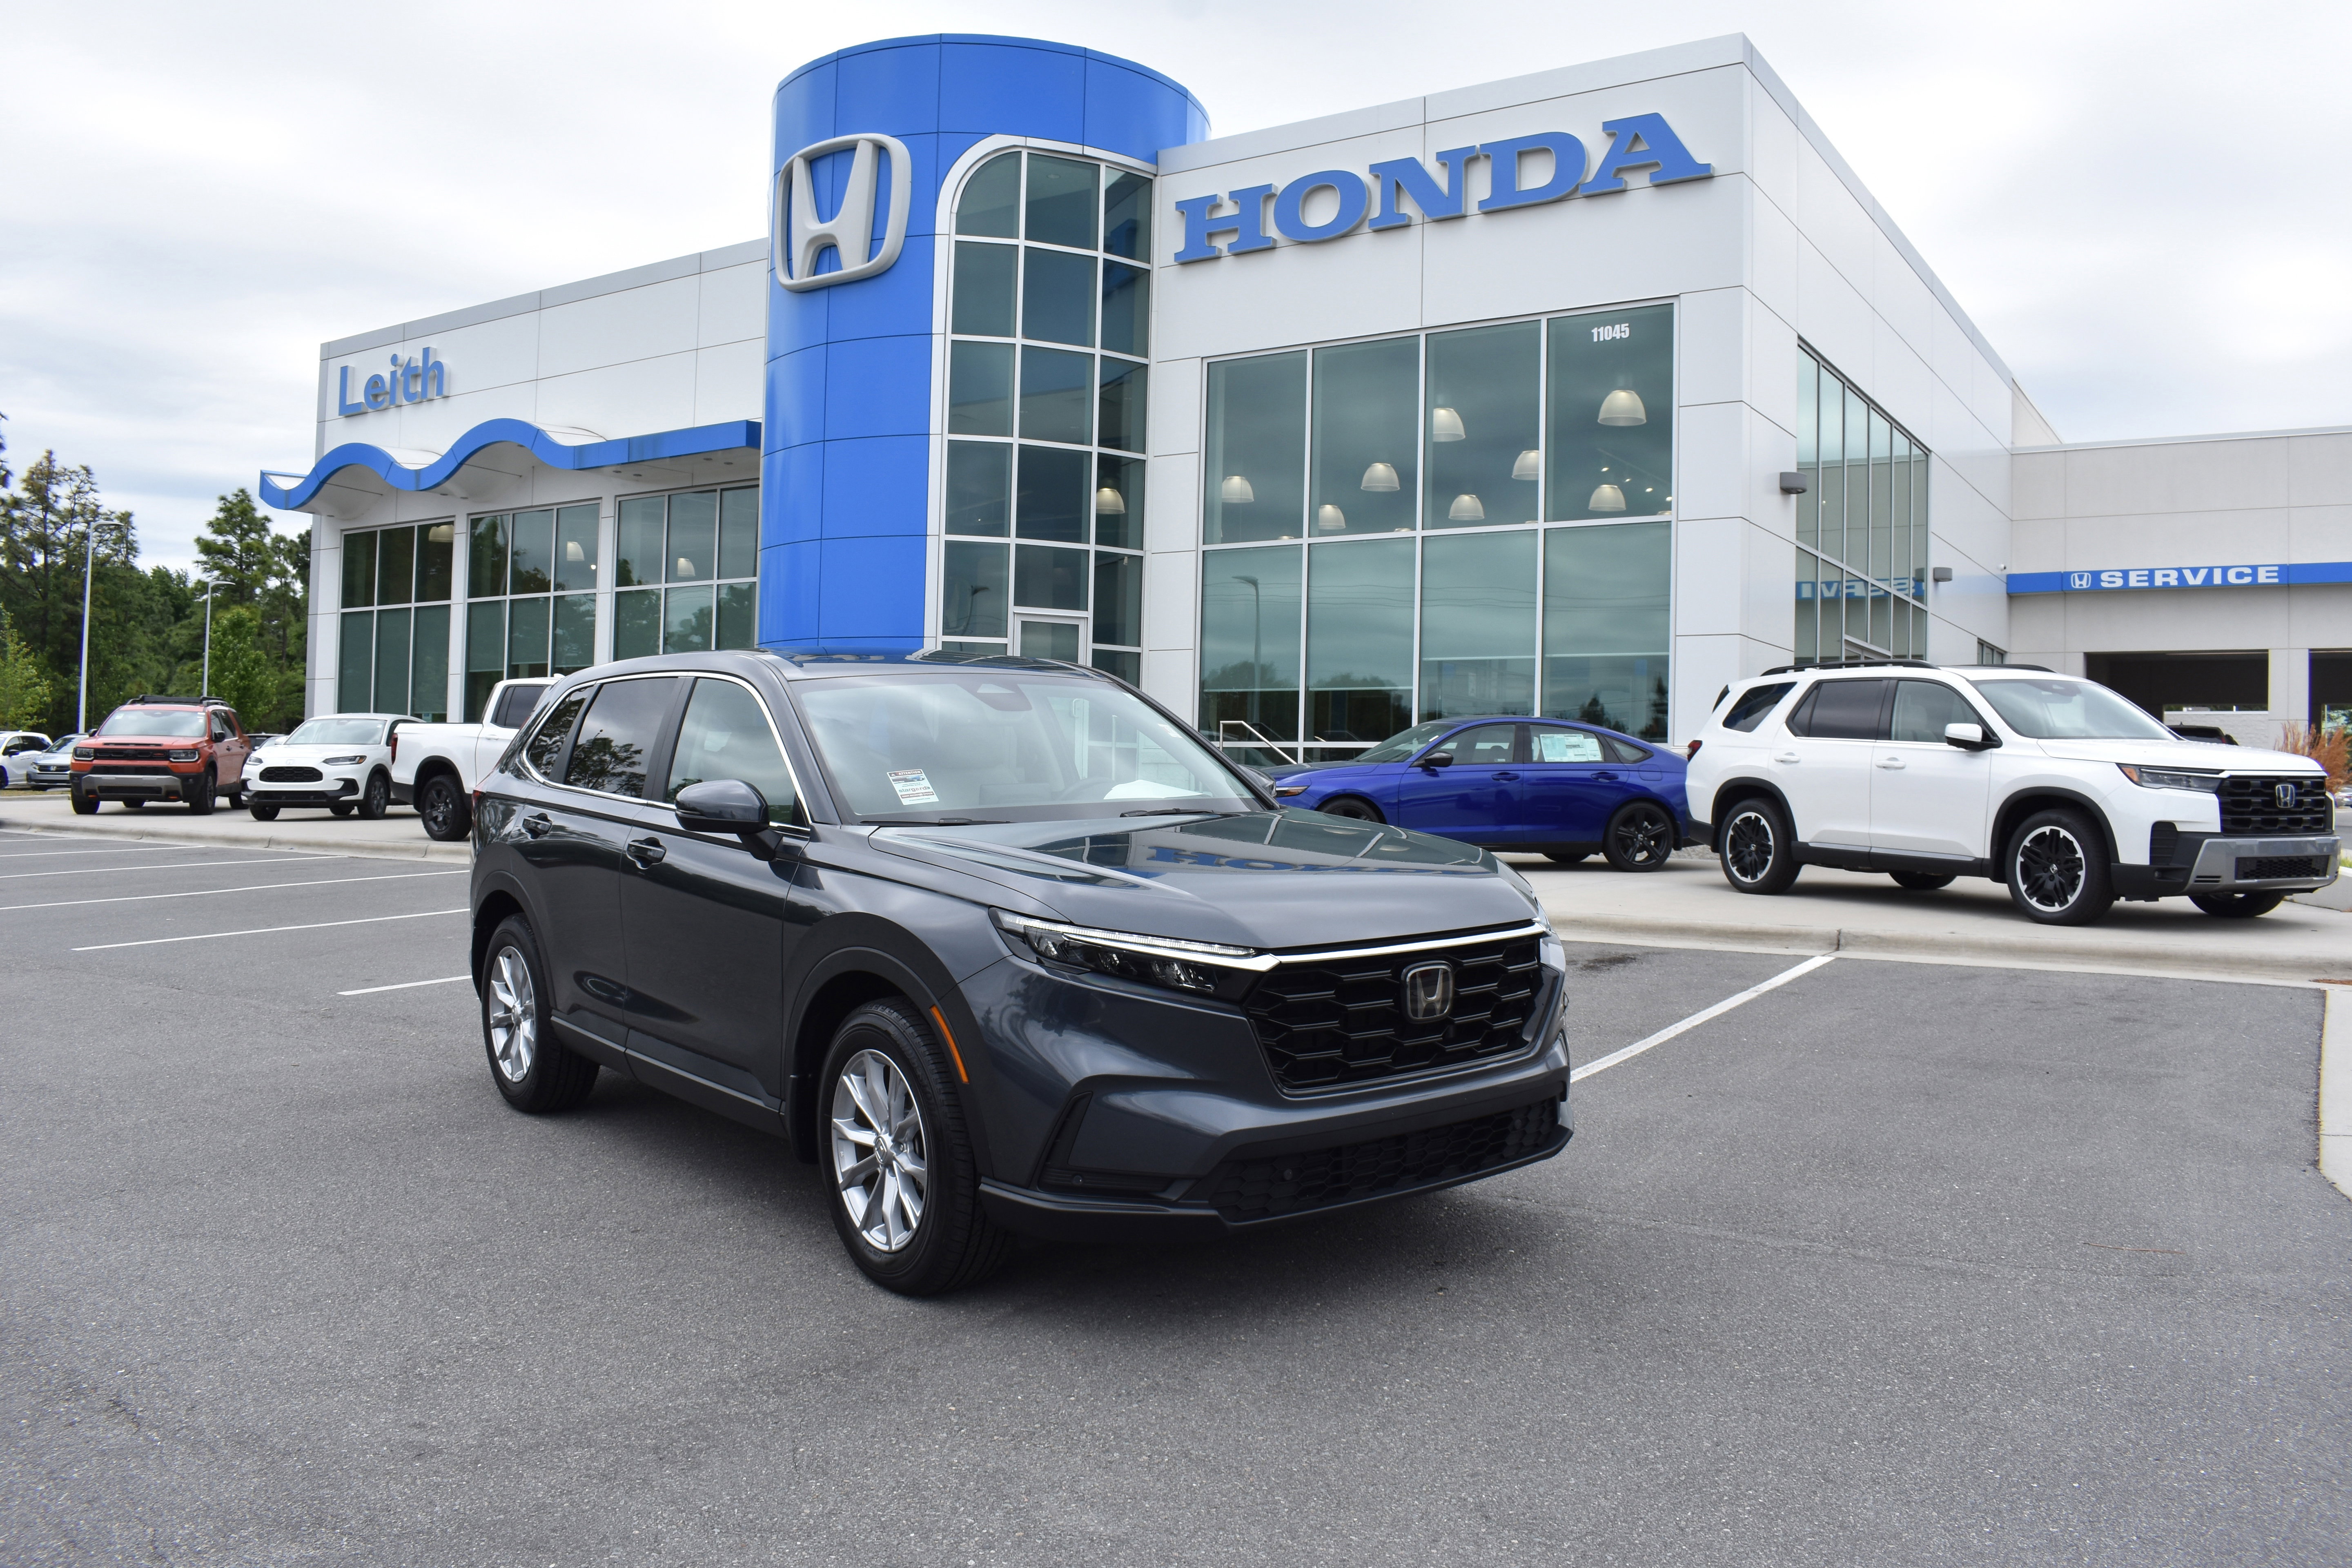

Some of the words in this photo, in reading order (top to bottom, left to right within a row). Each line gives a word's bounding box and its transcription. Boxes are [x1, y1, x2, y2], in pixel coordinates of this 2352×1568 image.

[1174, 112, 1713, 263] HONDA
[1591, 323, 1630, 342] 11045
[339, 347, 445, 416] Leith
[2100, 566, 2279, 588] SERVICE
